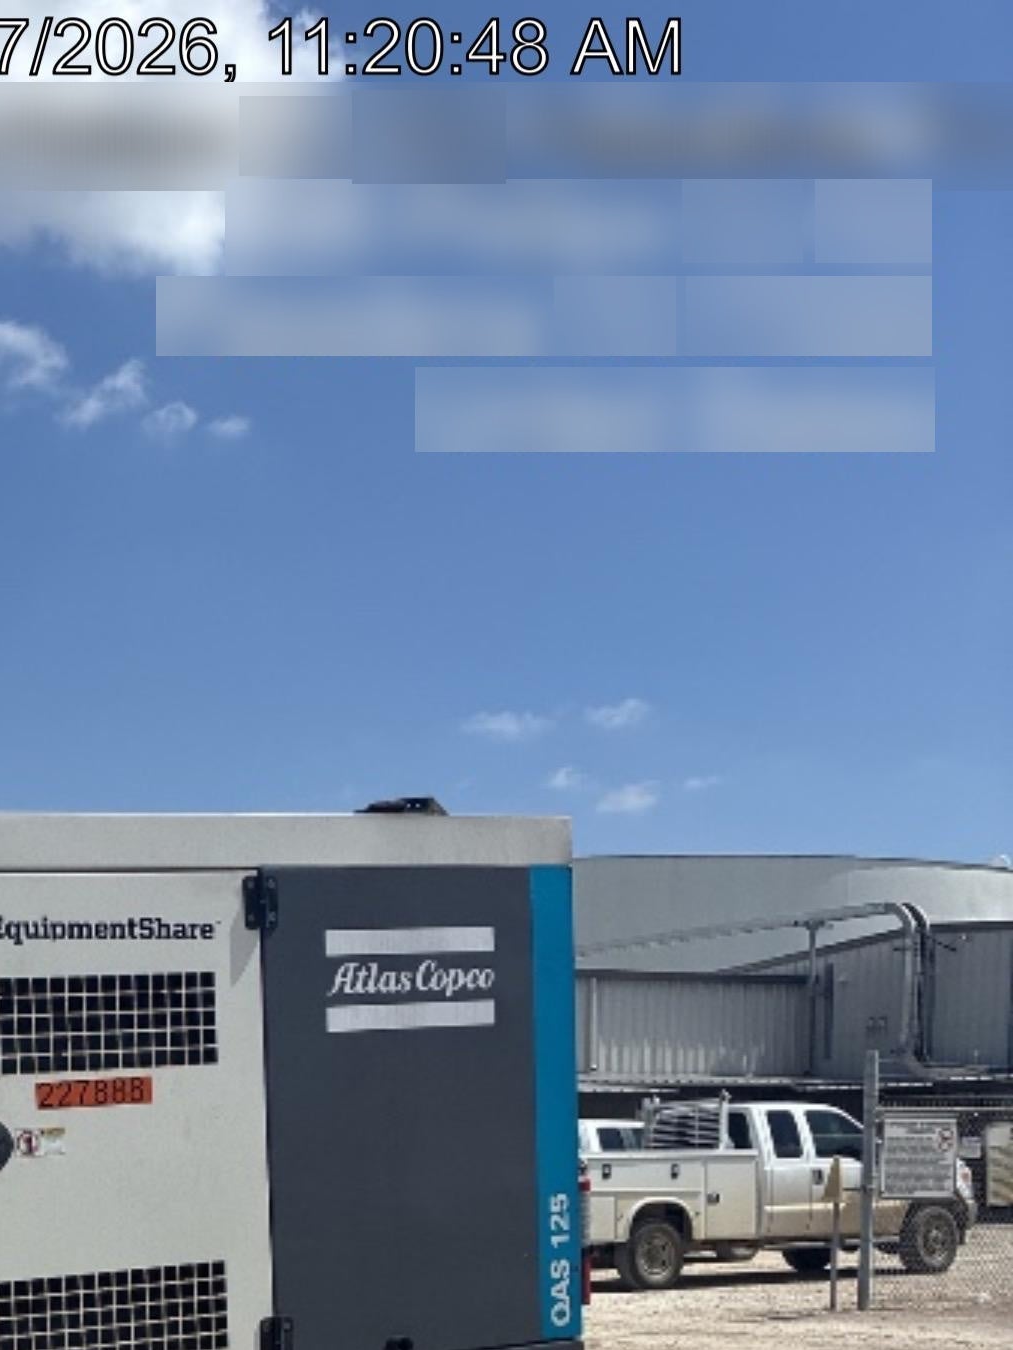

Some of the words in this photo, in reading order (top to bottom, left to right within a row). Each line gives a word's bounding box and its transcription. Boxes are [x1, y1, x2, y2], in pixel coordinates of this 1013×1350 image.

[326, 962, 412, 996] Atlas
[415, 959, 495, 997] Copco
[550, 1193, 570, 1248] 125
[550, 1259, 570, 1327] QAS
